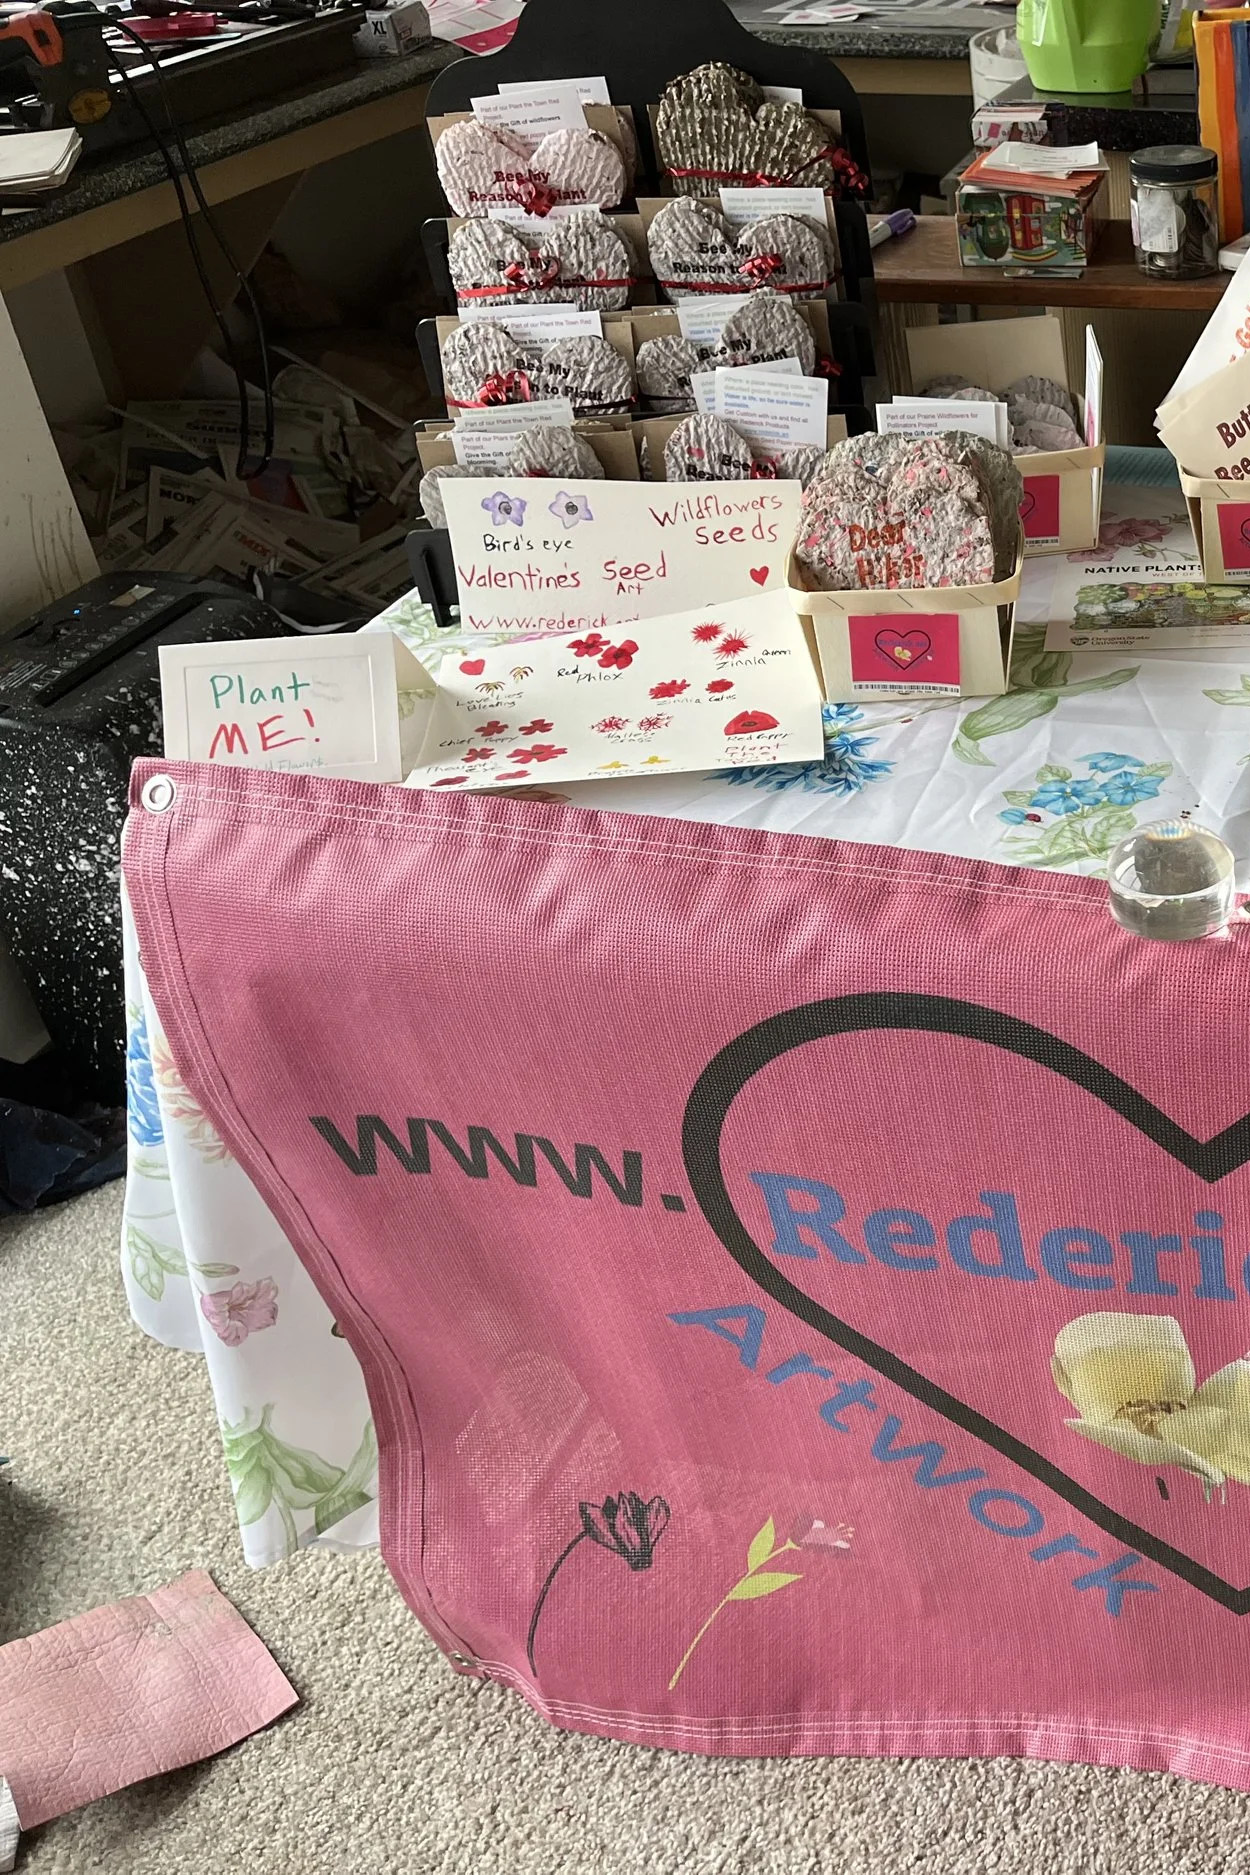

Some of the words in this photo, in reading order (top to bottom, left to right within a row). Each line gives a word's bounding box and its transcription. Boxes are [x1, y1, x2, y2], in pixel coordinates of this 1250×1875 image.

[372, 21, 387, 35] XL
[529, 115, 561, 124] wildflowers
[673, 262, 726, 274] Reason
[516, 359, 544, 373] Bee
[549, 364, 571, 379] My
[564, 387, 603, 401] Plant
[648, 495, 782, 527] Wildflowers
[483, 534, 534, 552] Bird's
[543, 540, 574, 552] eye
[458, 562, 581, 592] Valentine's
[1084, 566, 1140, 575] NATIVE
[616, 581, 644, 595] Art
[557, 665, 579, 678] Red
[715, 656, 767, 671] Zinnia
[209, 671, 310, 709] Plant
[209, 708, 320, 759] ME!
[305, 1109, 690, 1216] www.
[663, 1294, 1162, 1619] Artwork
